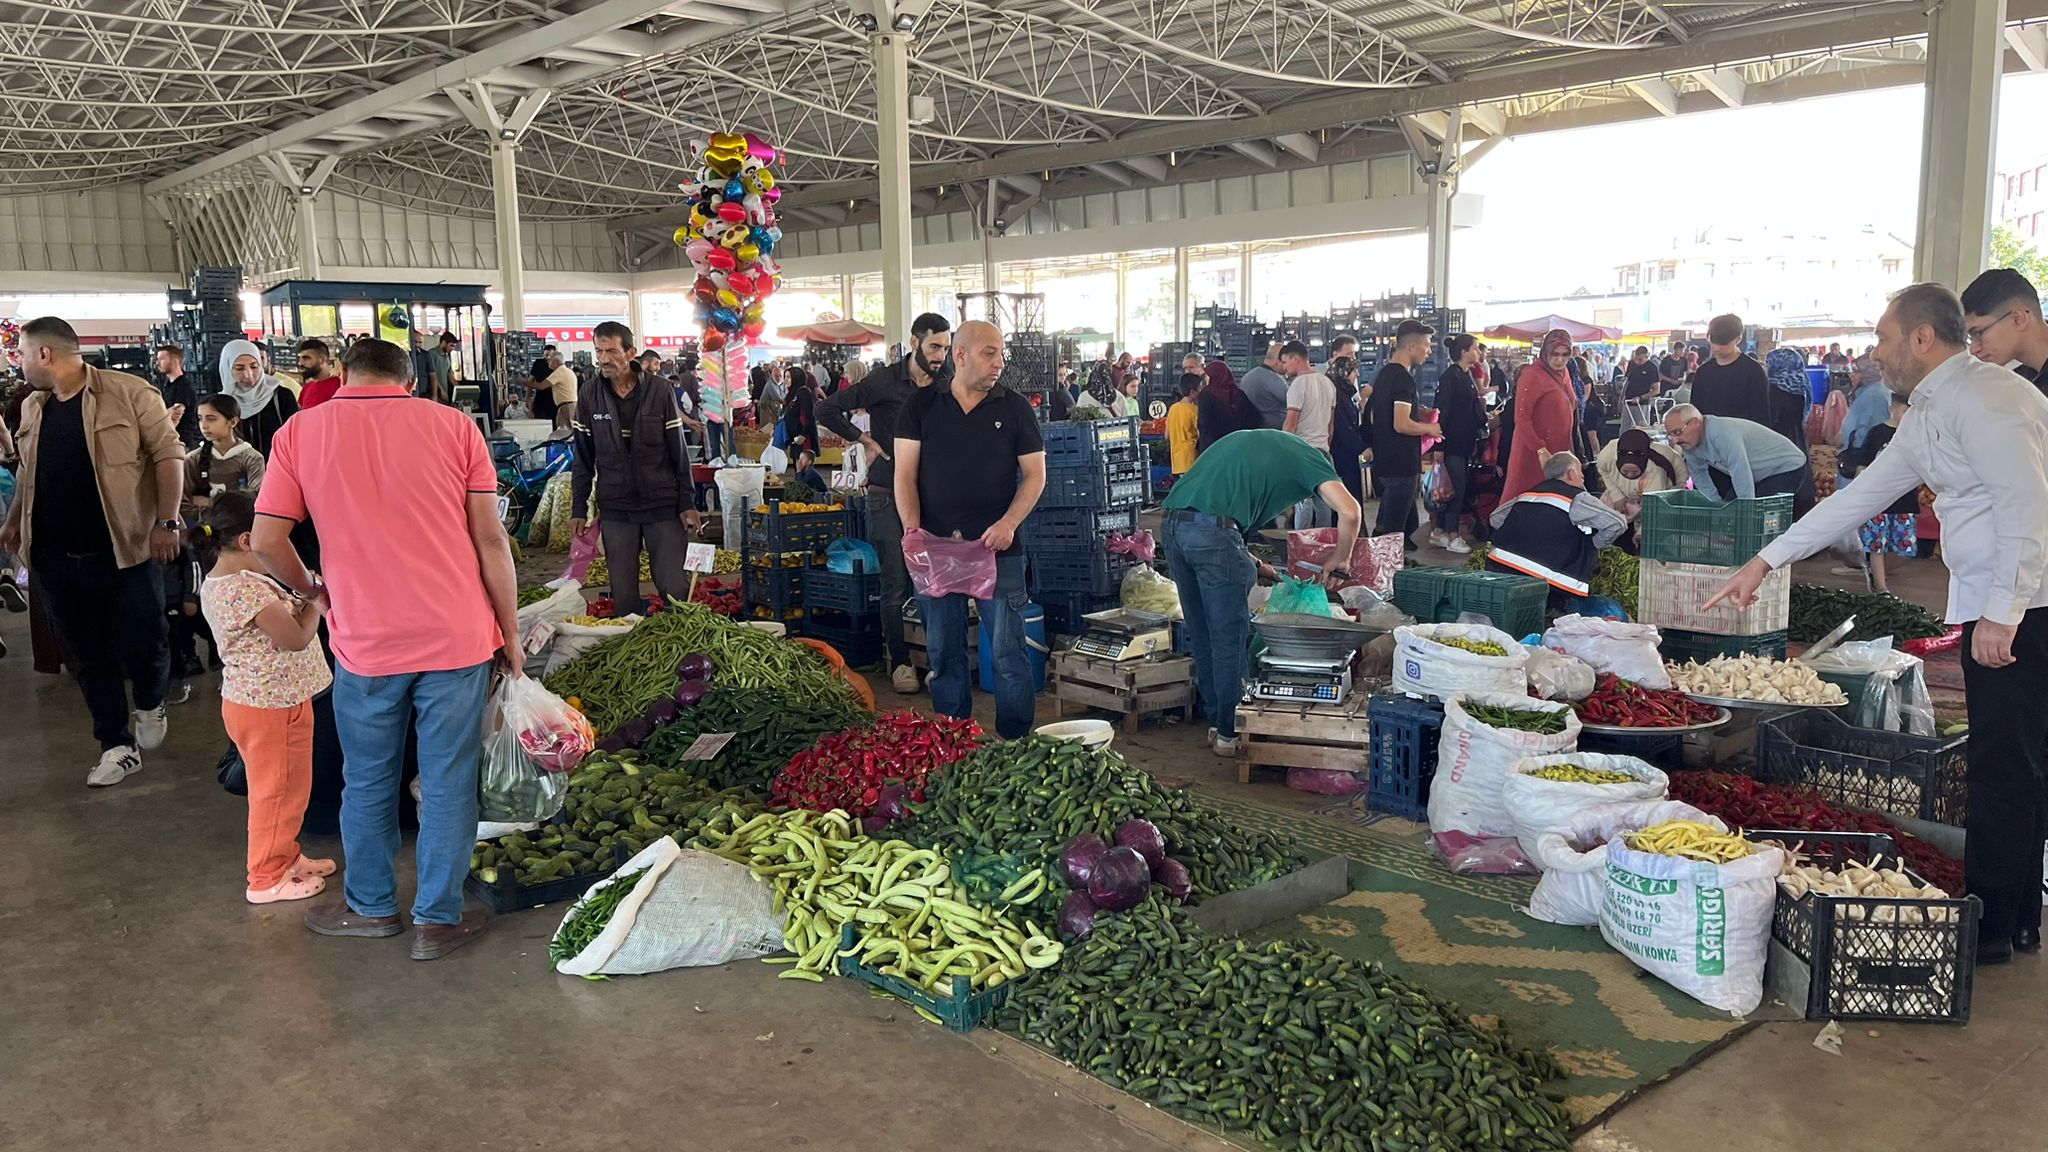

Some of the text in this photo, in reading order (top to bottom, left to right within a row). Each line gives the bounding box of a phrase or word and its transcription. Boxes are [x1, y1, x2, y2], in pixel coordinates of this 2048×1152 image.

[1151, 404, 1163, 416] 10
[833, 472, 855, 489] 20
[1648, 913, 1661, 924] 70
